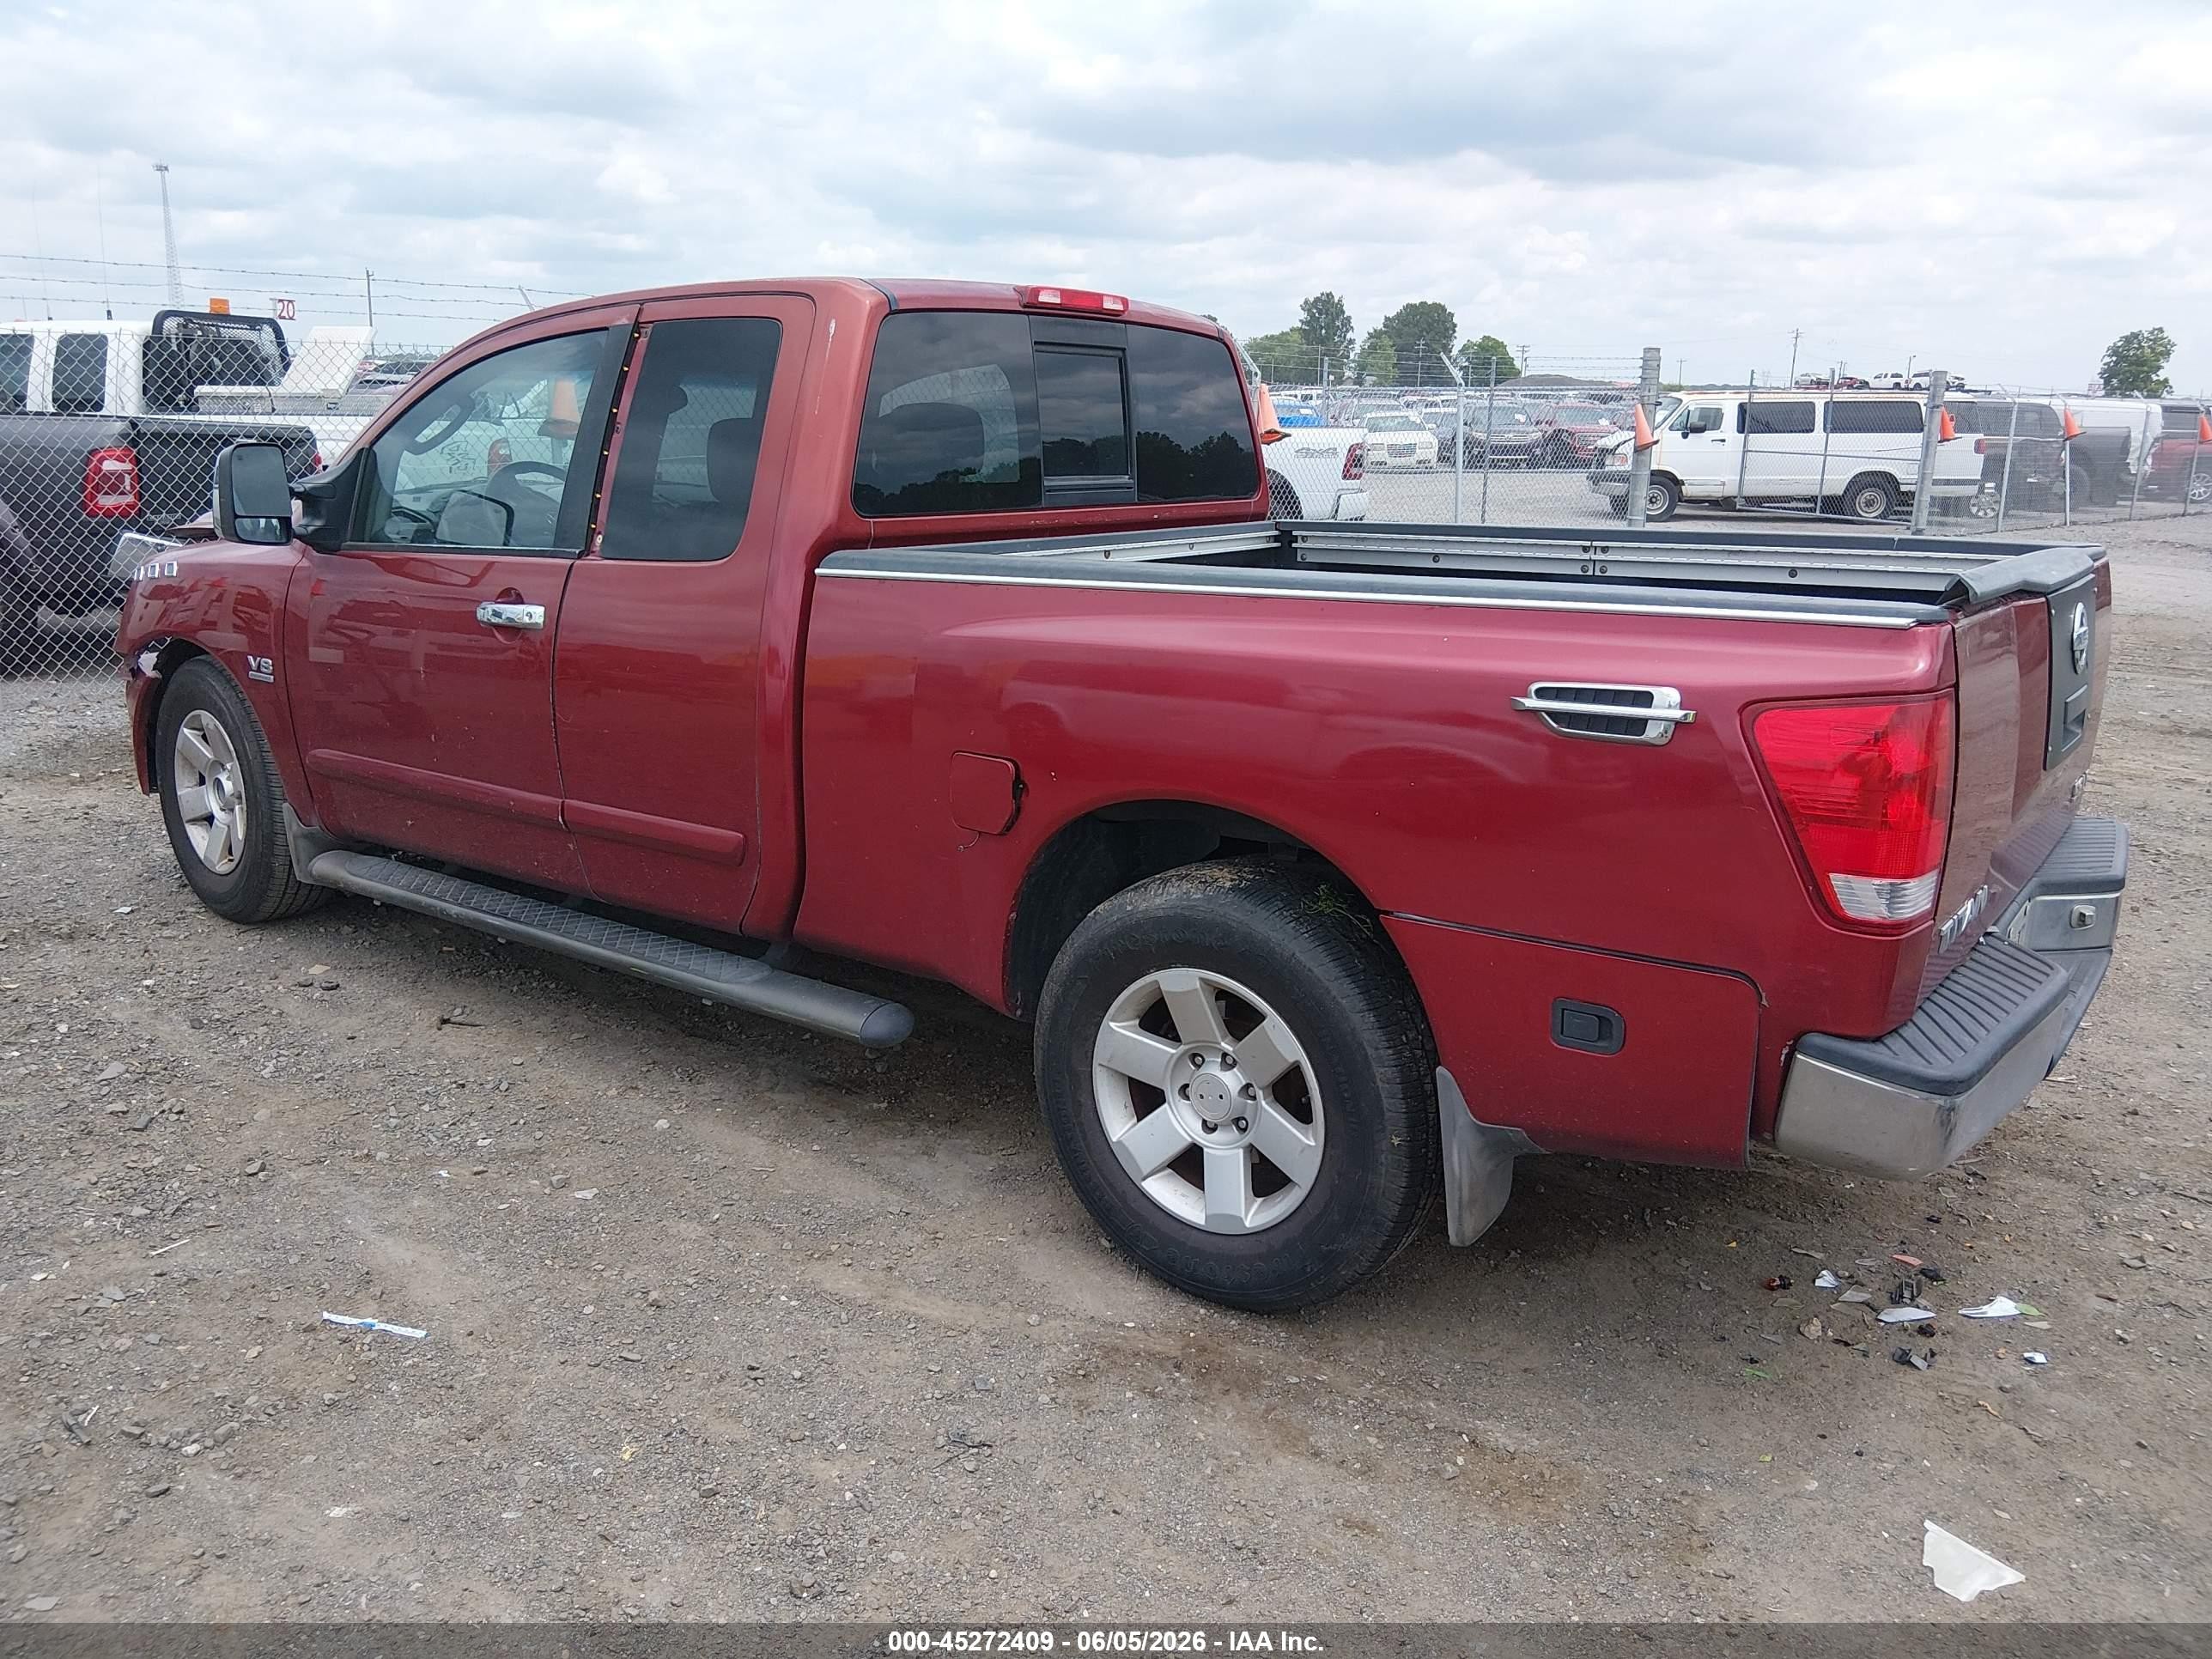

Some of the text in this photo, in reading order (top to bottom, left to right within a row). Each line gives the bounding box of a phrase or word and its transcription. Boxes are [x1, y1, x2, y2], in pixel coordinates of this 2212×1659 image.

[277, 299, 295, 319] 20
[246, 655, 273, 674] V8
[1938, 884, 1988, 955] TITAN
